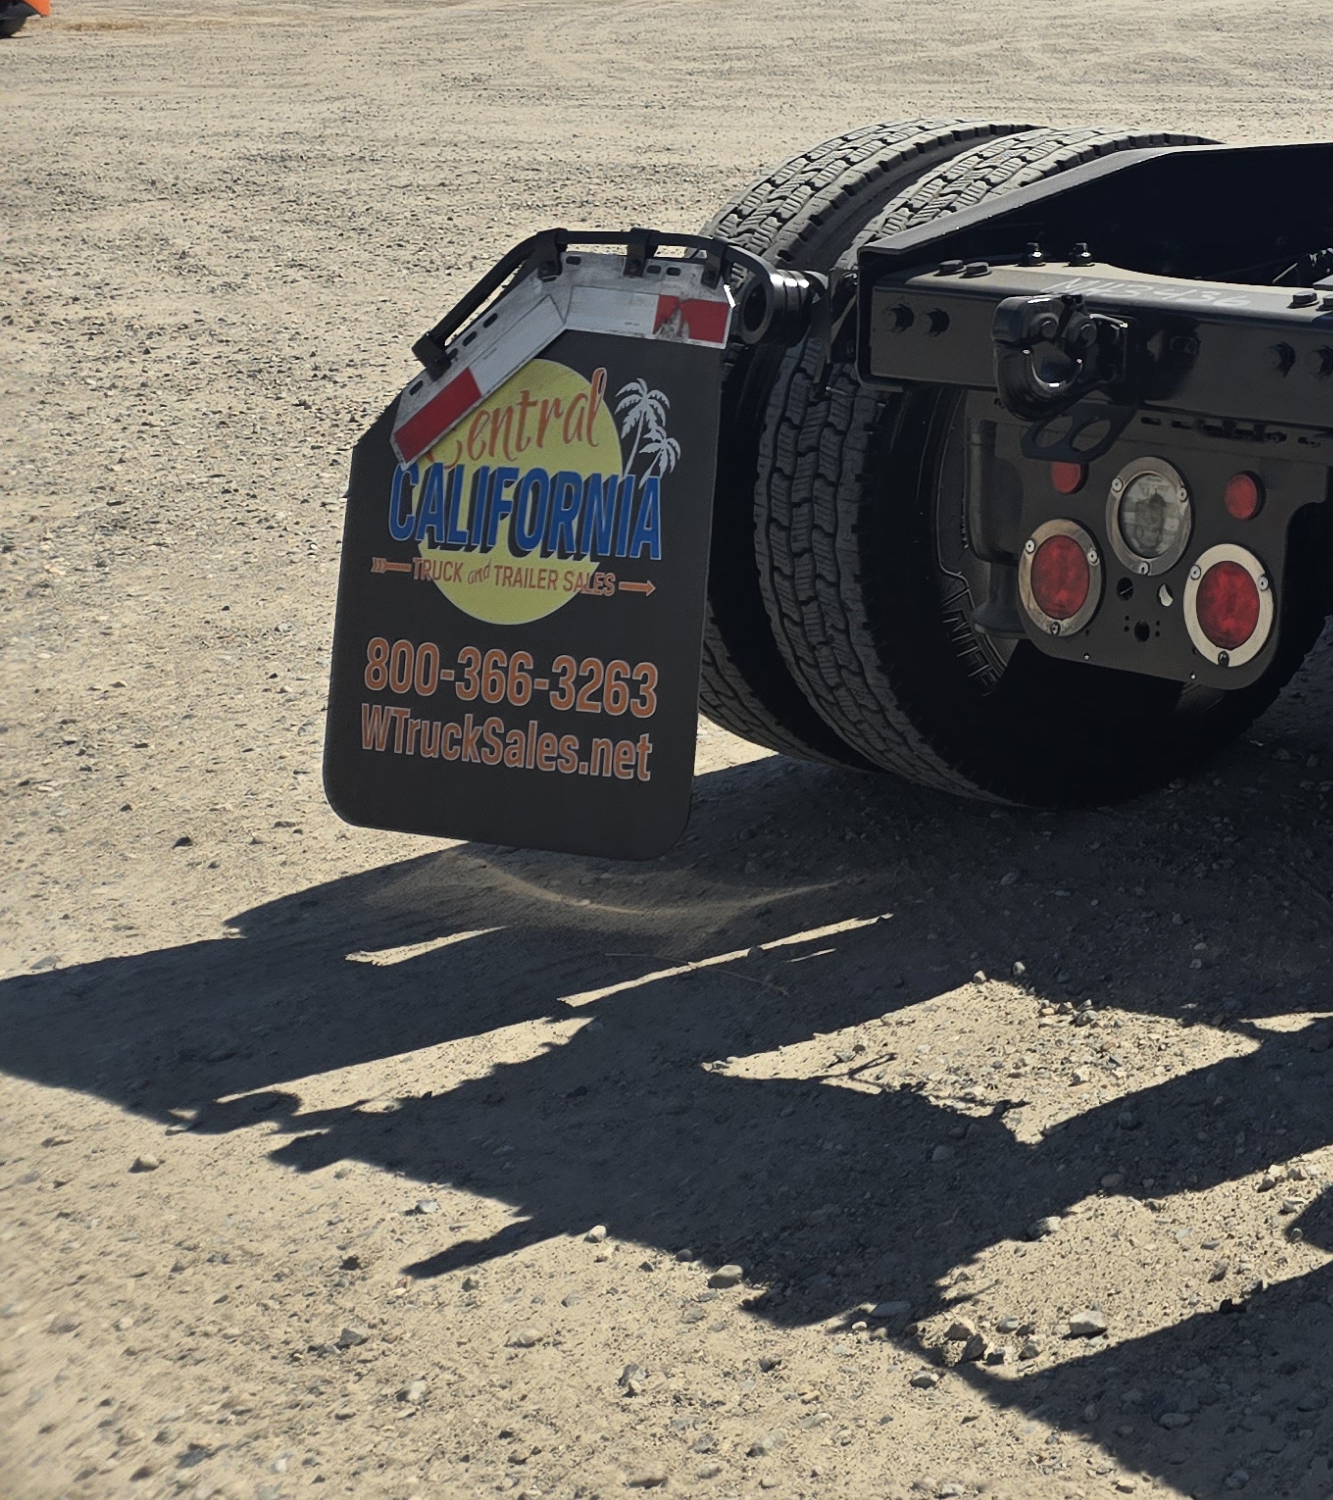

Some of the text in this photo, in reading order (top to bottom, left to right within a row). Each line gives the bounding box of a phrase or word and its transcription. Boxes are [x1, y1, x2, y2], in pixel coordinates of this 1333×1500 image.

[388, 462, 662, 561] CALIFORNIA
[413, 557, 616, 596] TRUCK and TRAILER SALES
[364, 636, 659, 718] 800-366-3263
[361, 703, 653, 782] WTruckSales.net
